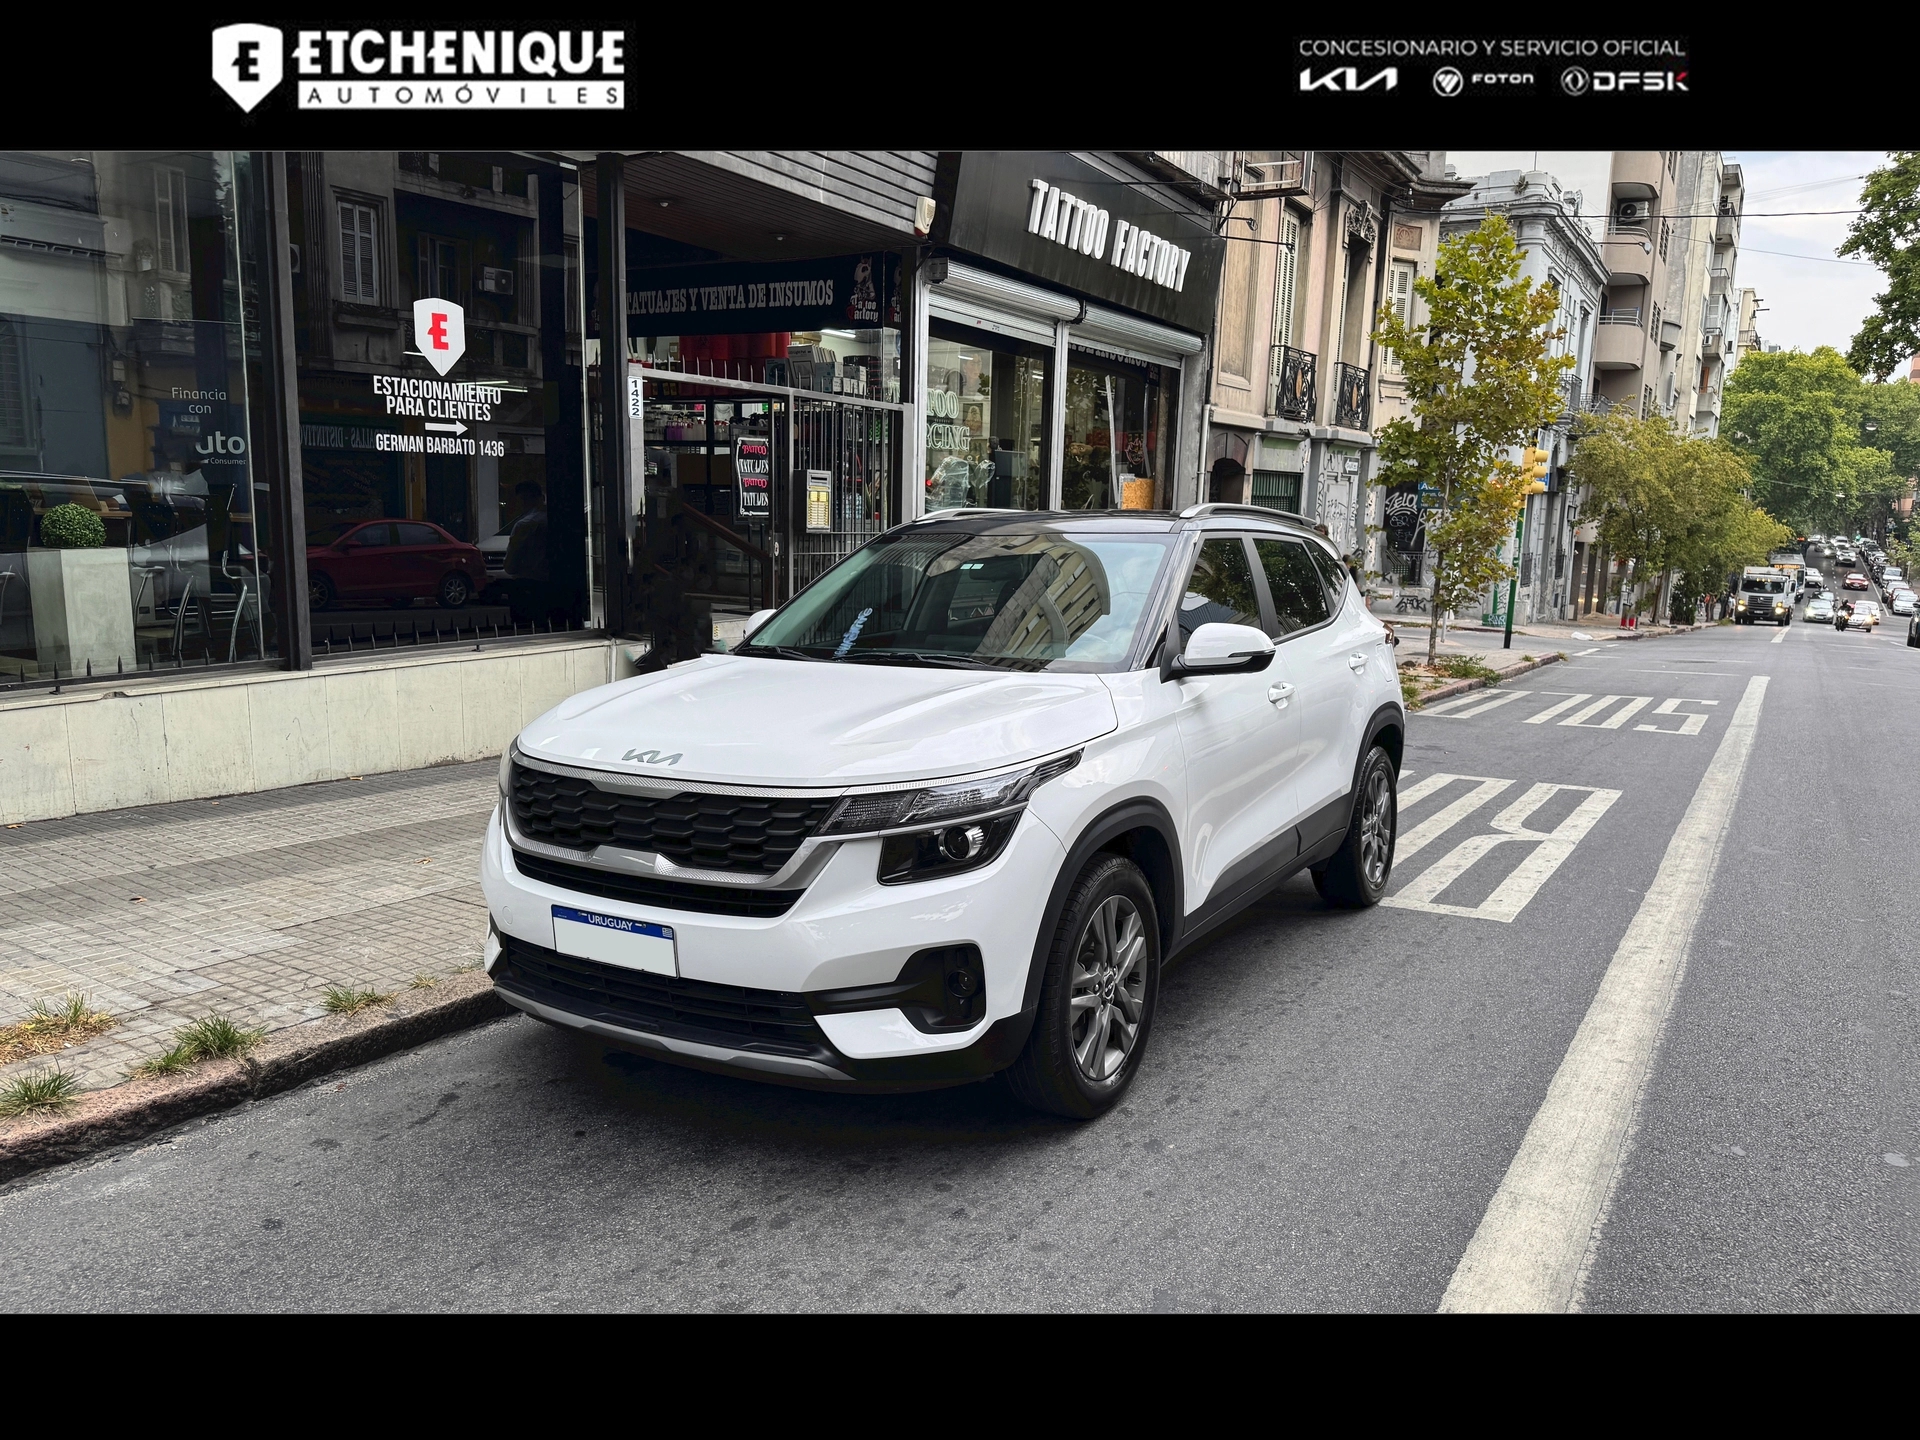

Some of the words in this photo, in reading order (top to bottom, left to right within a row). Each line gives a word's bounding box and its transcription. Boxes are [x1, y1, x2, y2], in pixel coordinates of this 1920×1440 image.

[1026, 178, 1111, 260] TATTOO
[1110, 219, 1192, 293] FACTORY
[626, 288, 688, 316] TATUAJES
[689, 286, 700, 312] Y
[700, 284, 746, 311] VENTA
[748, 281, 767, 309] DE
[769, 279, 834, 307] INSUMOS
[171, 387, 227, 400] Financia
[373, 375, 501, 405] ESTACIONAMIENTO
[630, 379, 641, 417] 1422
[188, 404, 212, 414] con
[386, 395, 425, 417] PARA
[428, 399, 491, 421] CLIENTES
[375, 433, 424, 453] GERMAN
[426, 436, 476, 455] BARBATO
[479, 440, 505, 457] 1436
[210, 456, 246, 465] Consumer
[621, 748, 683, 766] KIA
[588, 914, 633, 931] URUGUAY
